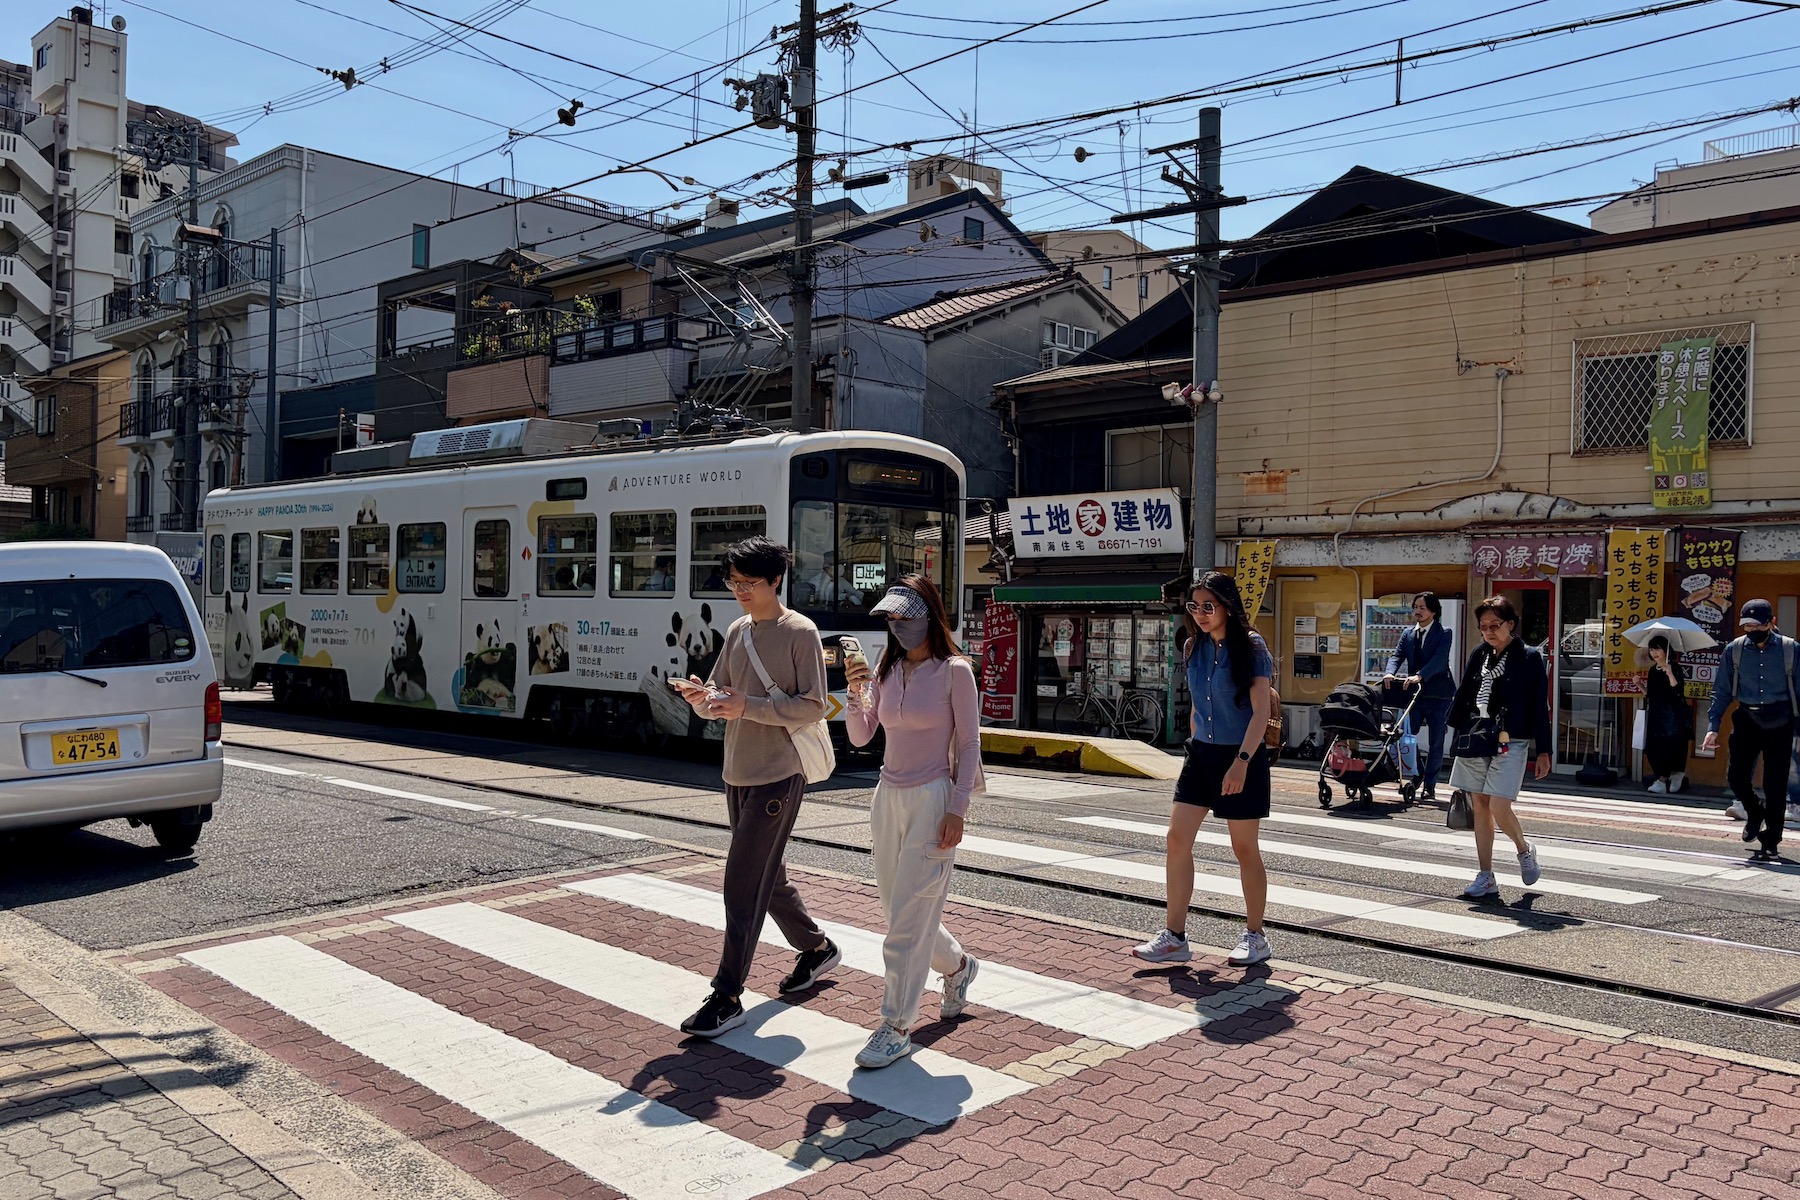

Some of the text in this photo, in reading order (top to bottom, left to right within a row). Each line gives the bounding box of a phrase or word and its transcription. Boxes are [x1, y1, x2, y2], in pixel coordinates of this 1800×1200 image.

[1692, 347, 1711, 392] 2階に
[1656, 350, 1674, 410] あります
[1671, 347, 1693, 440] 休憩スペース
[623, 470, 742, 491] ADVENTURE WORLD
[258, 506, 273, 517] HAPPY
[275, 505, 293, 516] PANDA
[294, 504, 307, 514] 30th
[1033, 541, 1085, 552] 南海住宅
[1684, 540, 1733, 555] サクサク
[239, 563, 249, 575] 出口
[406, 560, 425, 573] 入口
[1686, 554, 1735, 570] もちもち
[233, 576, 249, 587] EXIT
[406, 576, 435, 588] ENTRANCE
[1627, 541, 1642, 626] もちもちの
[1645, 534, 1660, 620] もちもちの
[354, 628, 375, 645] 701
[156, 673, 201, 684] EVERY
[69, 741, 117, 761] 47-54
